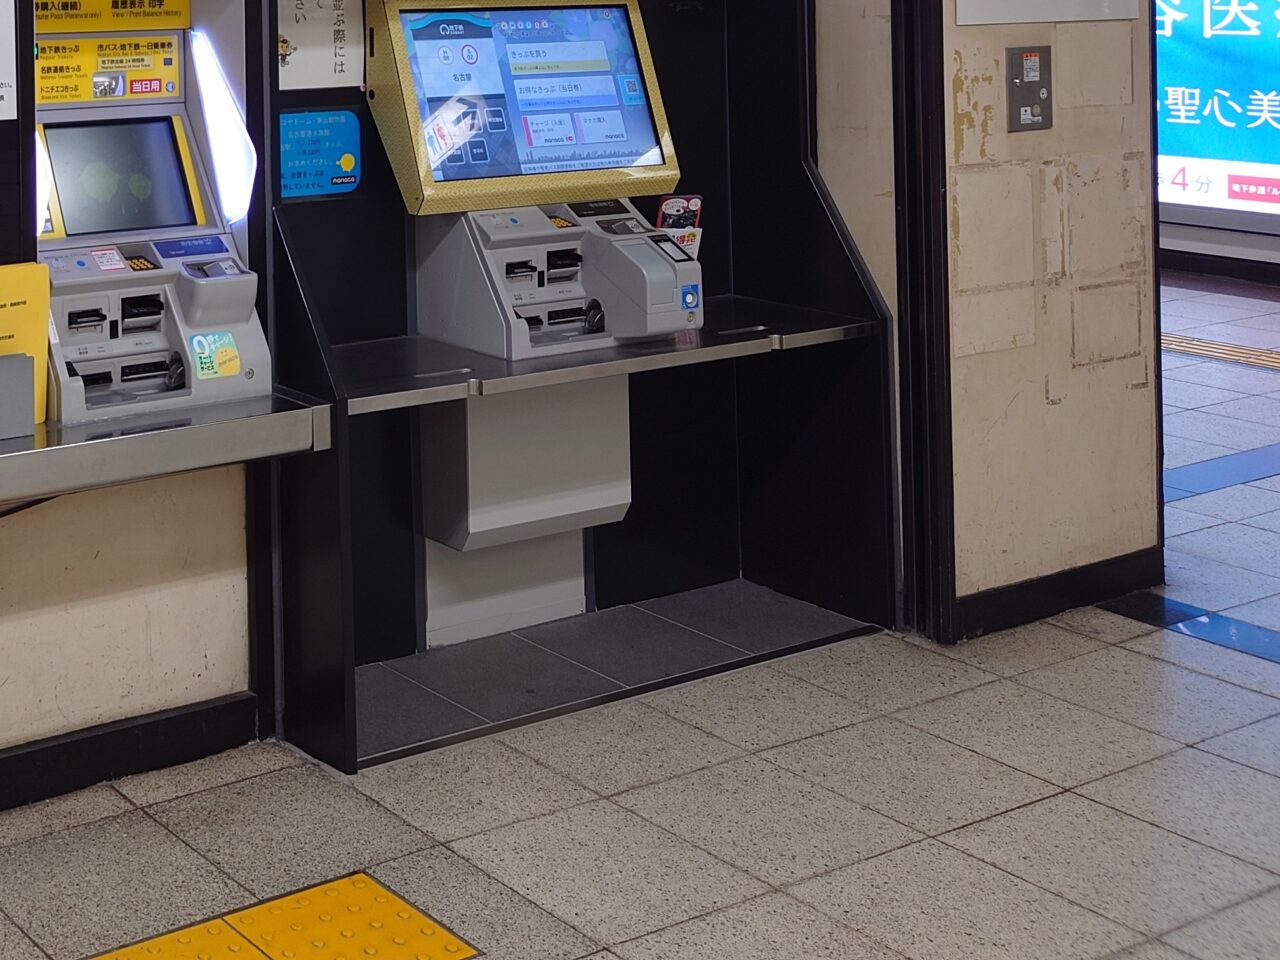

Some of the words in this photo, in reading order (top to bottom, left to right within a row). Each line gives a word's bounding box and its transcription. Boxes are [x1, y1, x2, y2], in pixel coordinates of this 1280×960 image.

[511, 49, 548, 59] きっぷを買う
[452, 73, 472, 82] 名古屋
[132, 81, 160, 93] 当日用
